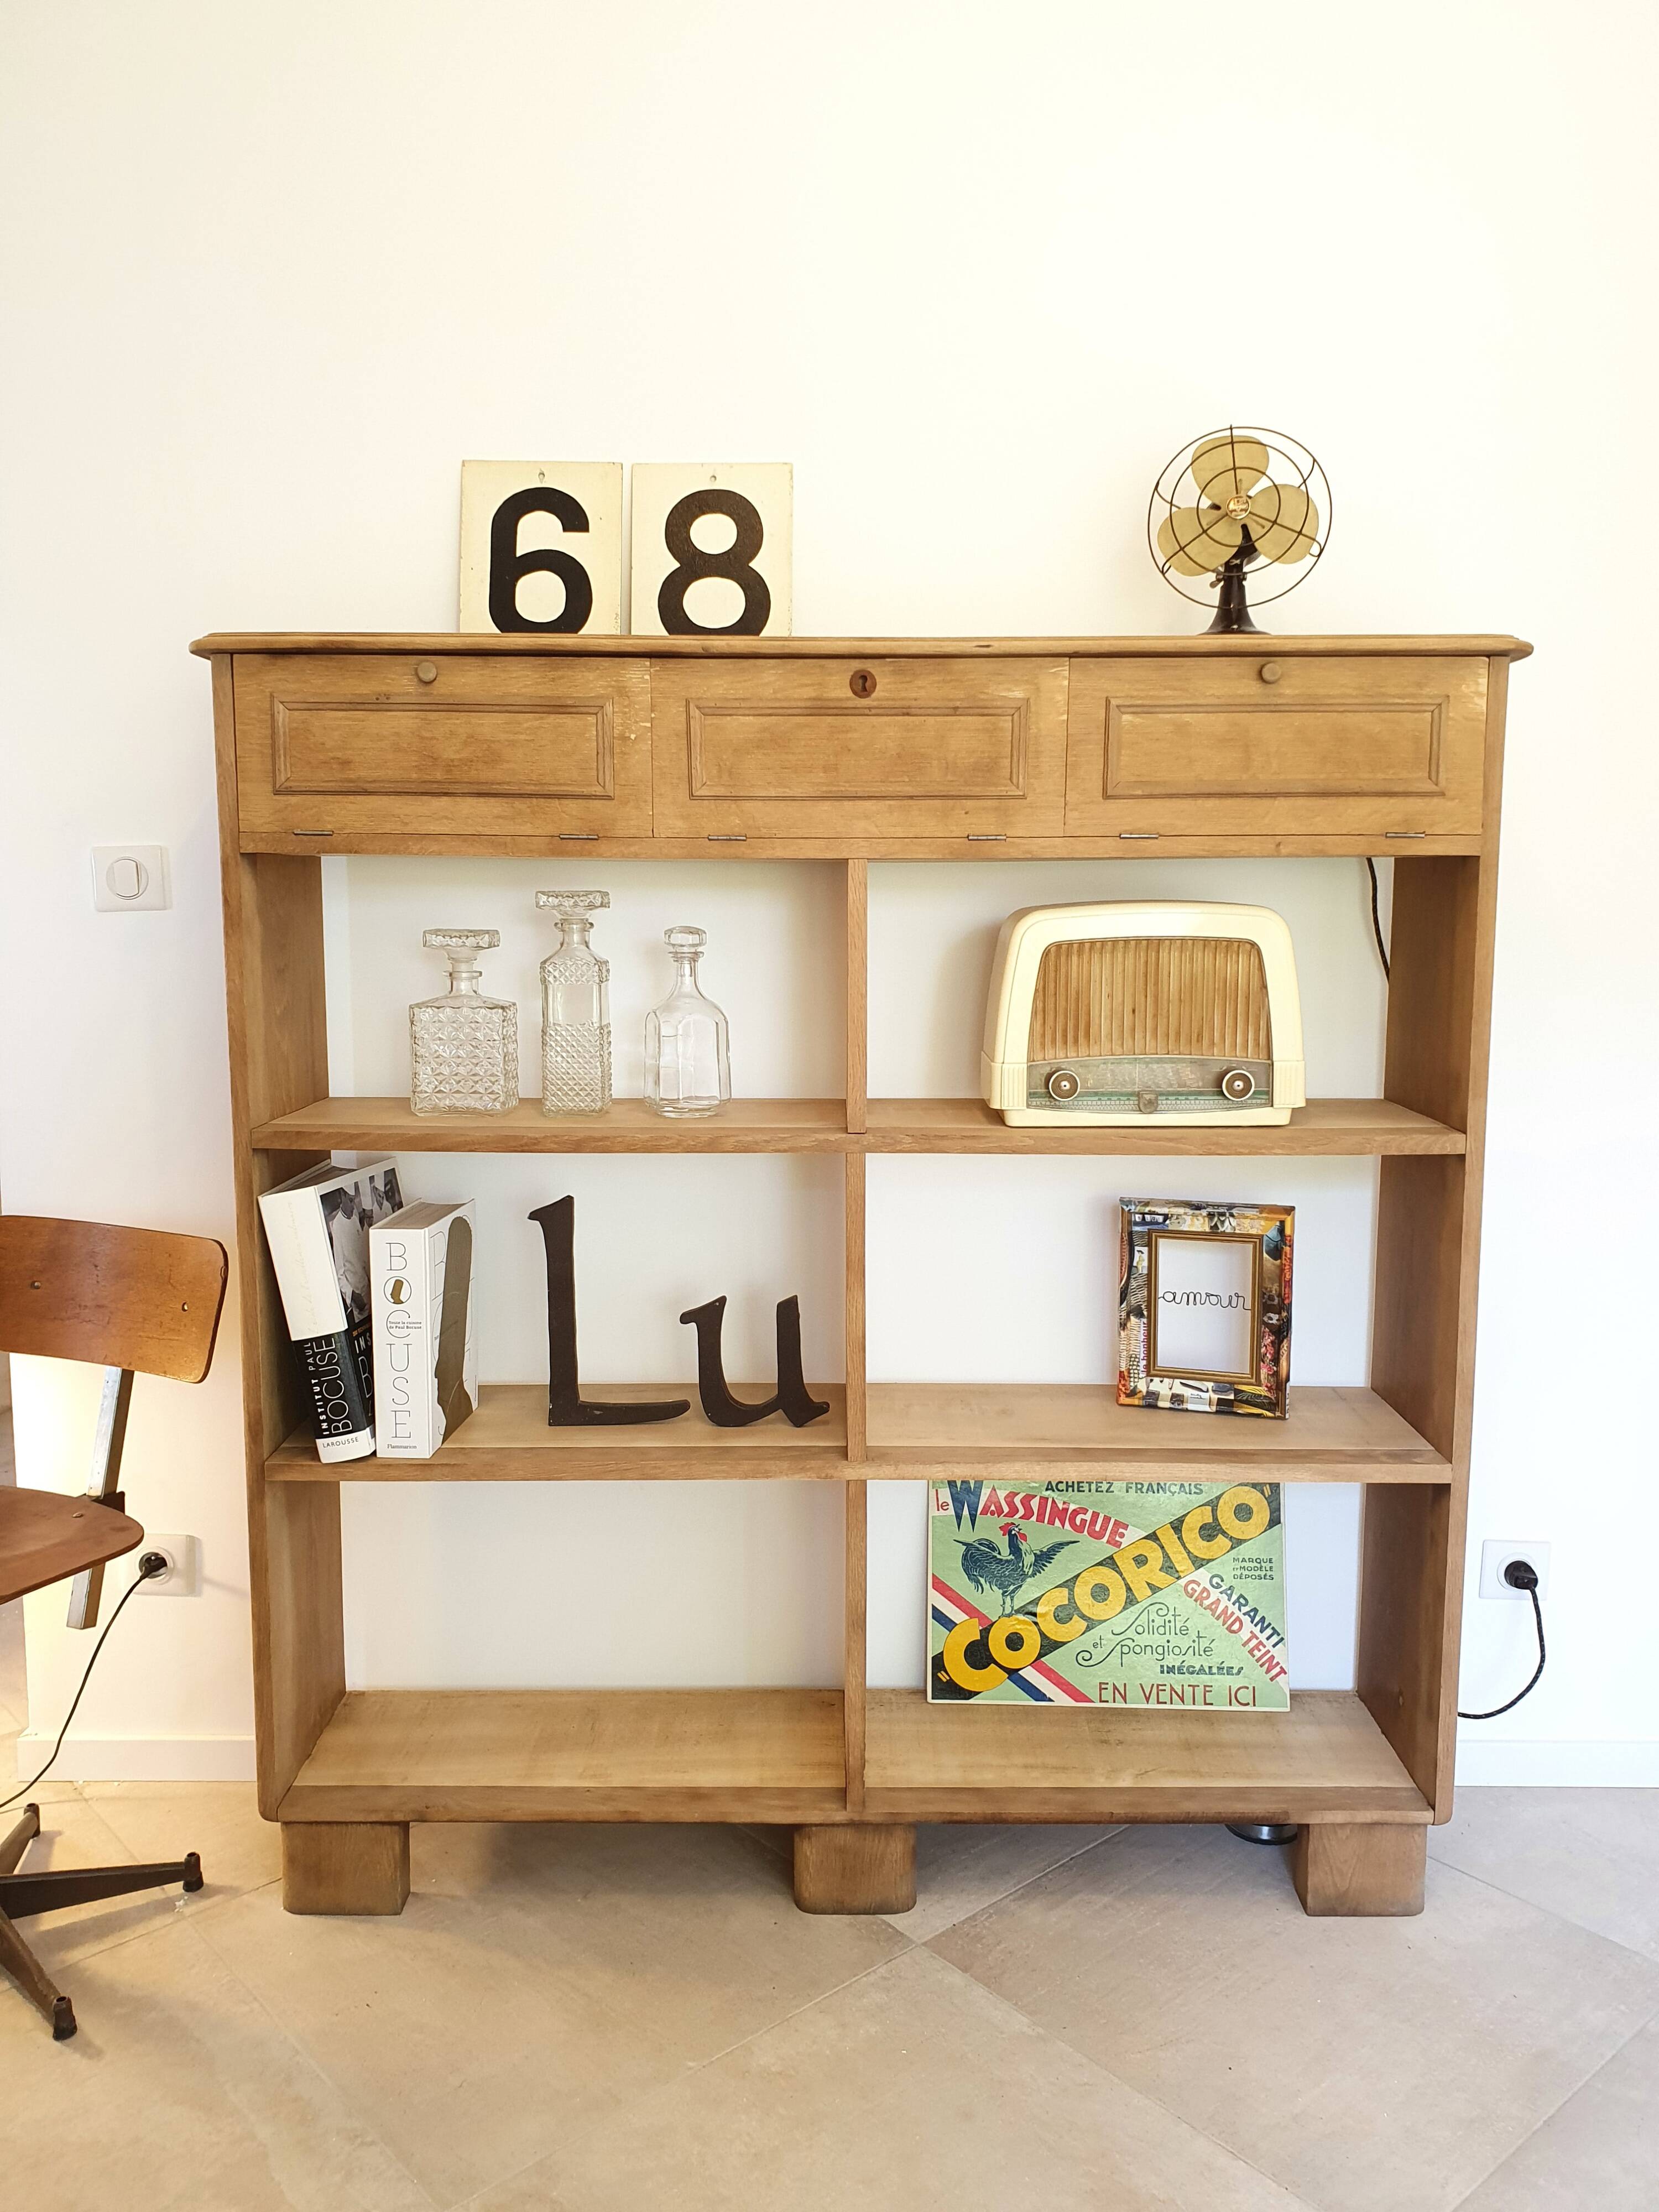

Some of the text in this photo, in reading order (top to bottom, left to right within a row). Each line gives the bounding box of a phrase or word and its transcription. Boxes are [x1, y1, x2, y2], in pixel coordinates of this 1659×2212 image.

[489, 487, 771, 637] 6 8
[528, 1194, 830, 1427] Lu
[1159, 1291, 1252, 1311] amour
[304, 1342, 330, 1434] INSTITUT PAUL
[313, 1338, 352, 1434] BOCUSE
[322, 1437, 359, 1448] LAROUSSE
[1045, 1481, 1204, 1496] ACHETEZ FRANÇAIS
[935, 1480, 1129, 1549] le WASSINGUE
[1233, 1572, 1274, 1580] DÉPOSÉS
[1112, 1602, 1190, 1636] Solidité
[1209, 1574, 1285, 1648] GARANTI
[1076, 1630, 1215, 1667] et Spongiosité
[1183, 1579, 1287, 1682] GRAND TEINT
[1160, 1660, 1244, 1676] INÉGALÉES
[1099, 1682, 1256, 1707] EN VENTE ICI
